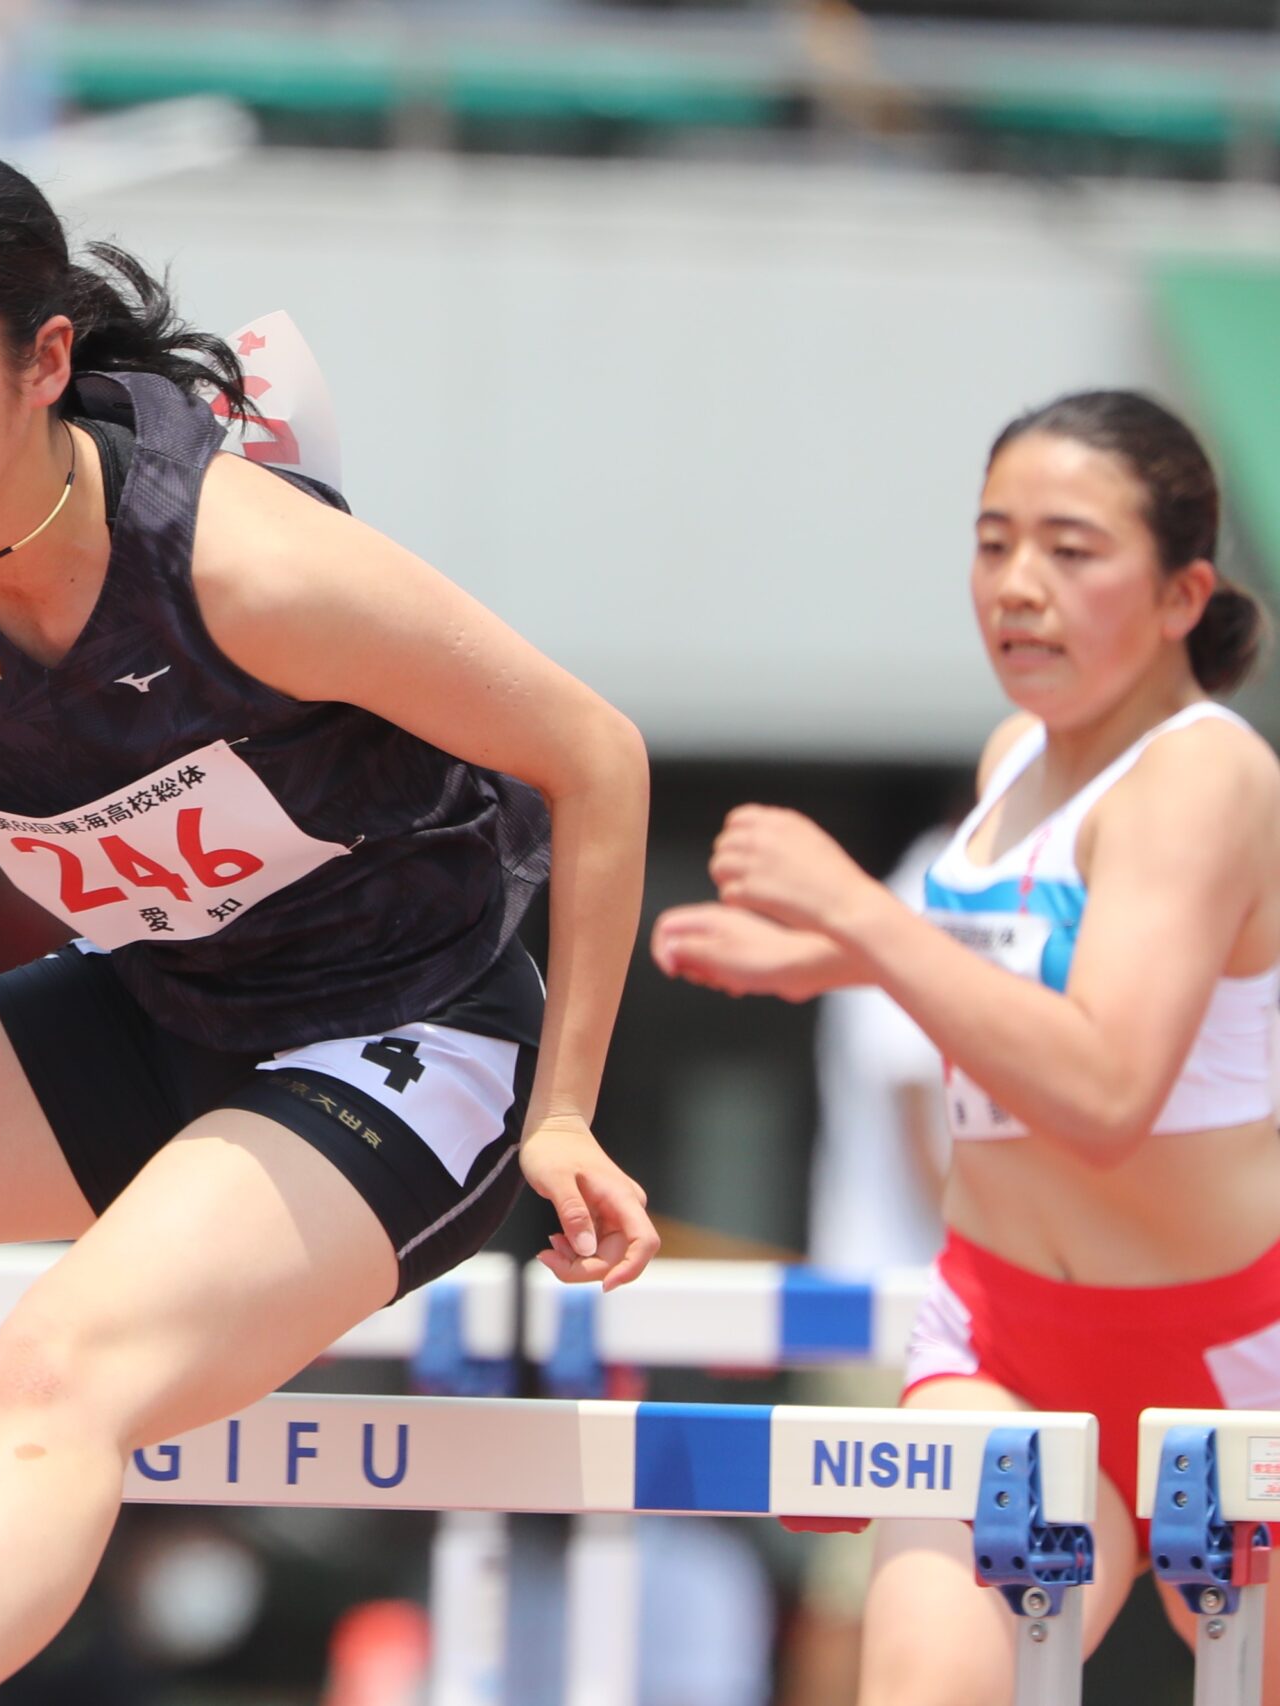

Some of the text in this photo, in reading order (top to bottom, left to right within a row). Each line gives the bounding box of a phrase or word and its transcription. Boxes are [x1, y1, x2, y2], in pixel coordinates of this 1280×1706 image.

[11, 807, 264, 914] 246
[360, 1036, 426, 1094] 4
[132, 1420, 409, 1489] GIFU
[812, 1439, 953, 1491] NISHI
